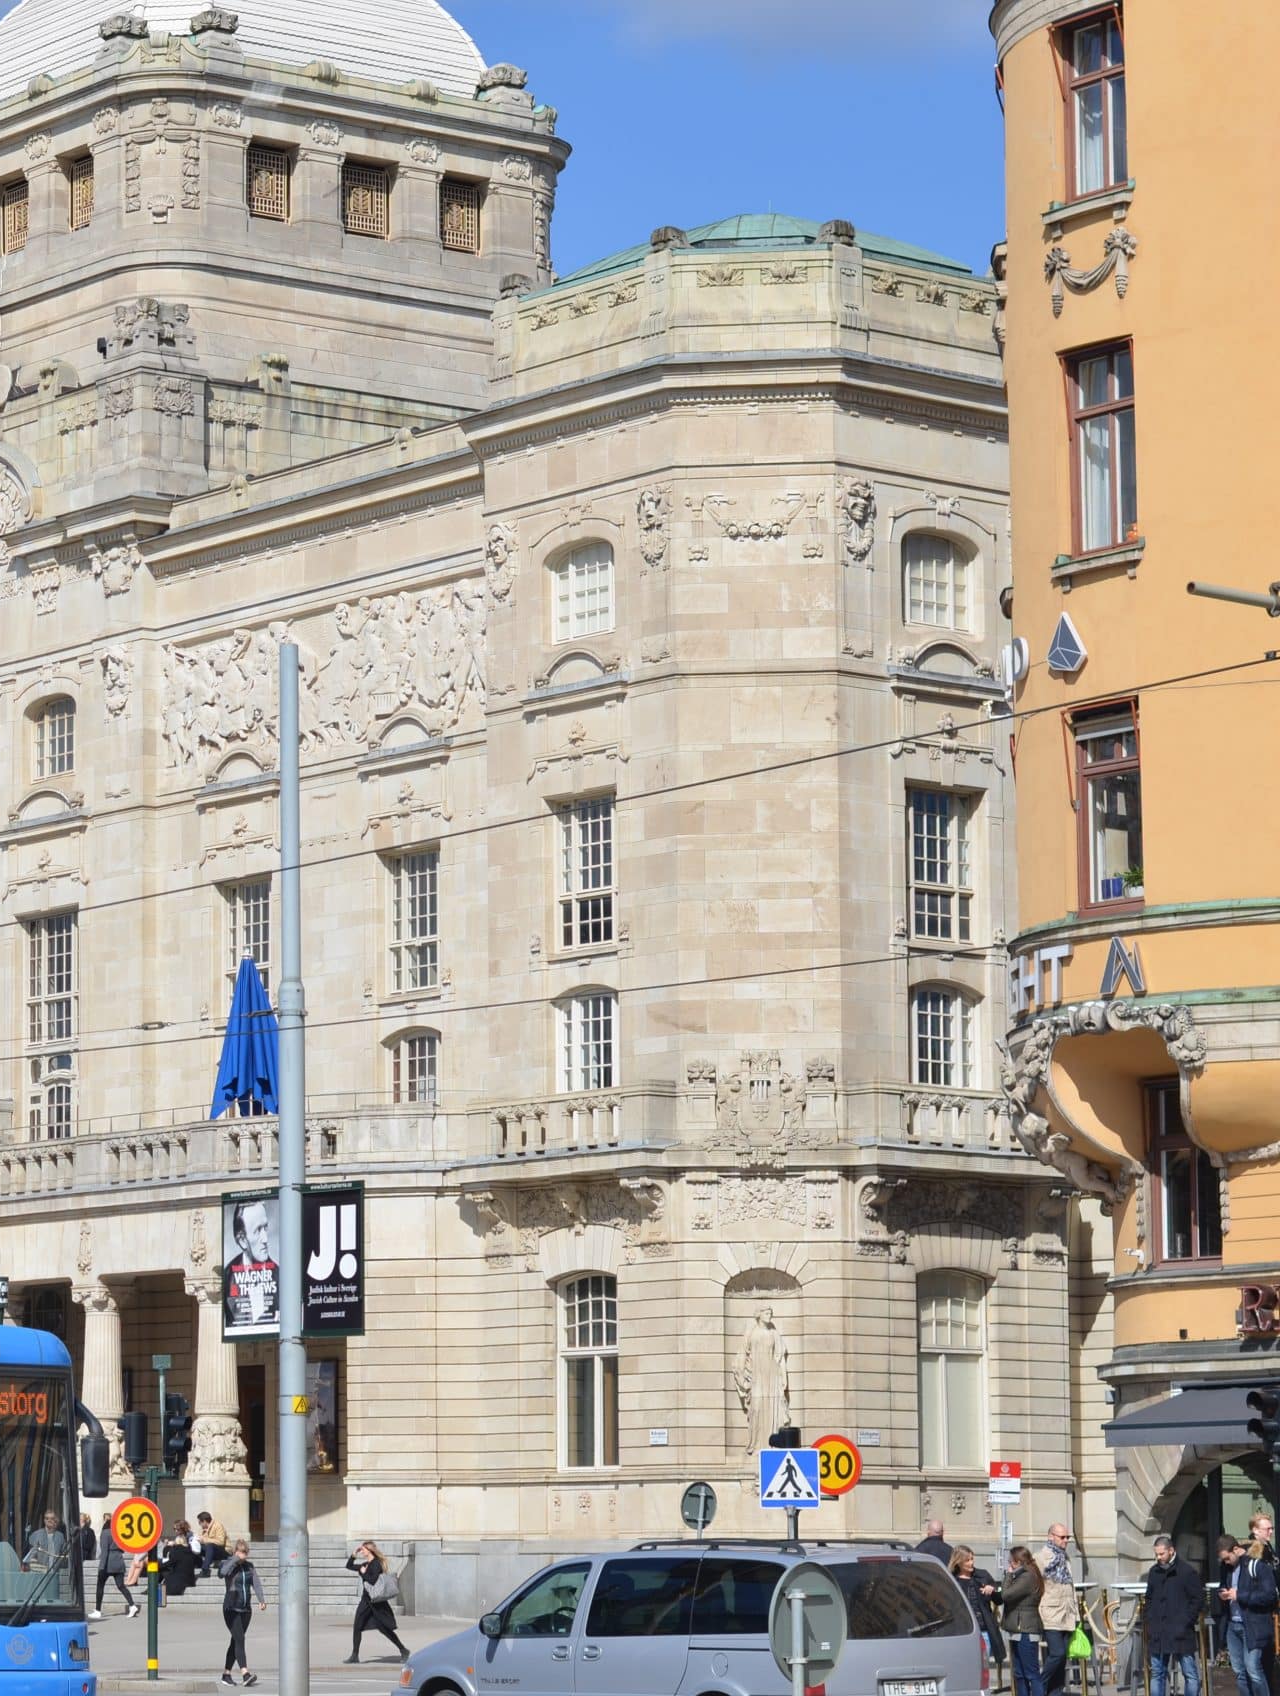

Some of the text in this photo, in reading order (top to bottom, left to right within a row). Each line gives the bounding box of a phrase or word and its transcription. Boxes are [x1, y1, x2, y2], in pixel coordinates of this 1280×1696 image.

[234, 1269, 273, 1284] WAGNER
[1239, 1284, 1280, 1331] R
[820, 1450, 853, 1480] 30
[120, 1512, 155, 1539] 30
[885, 1681, 934, 1695] THE 914
